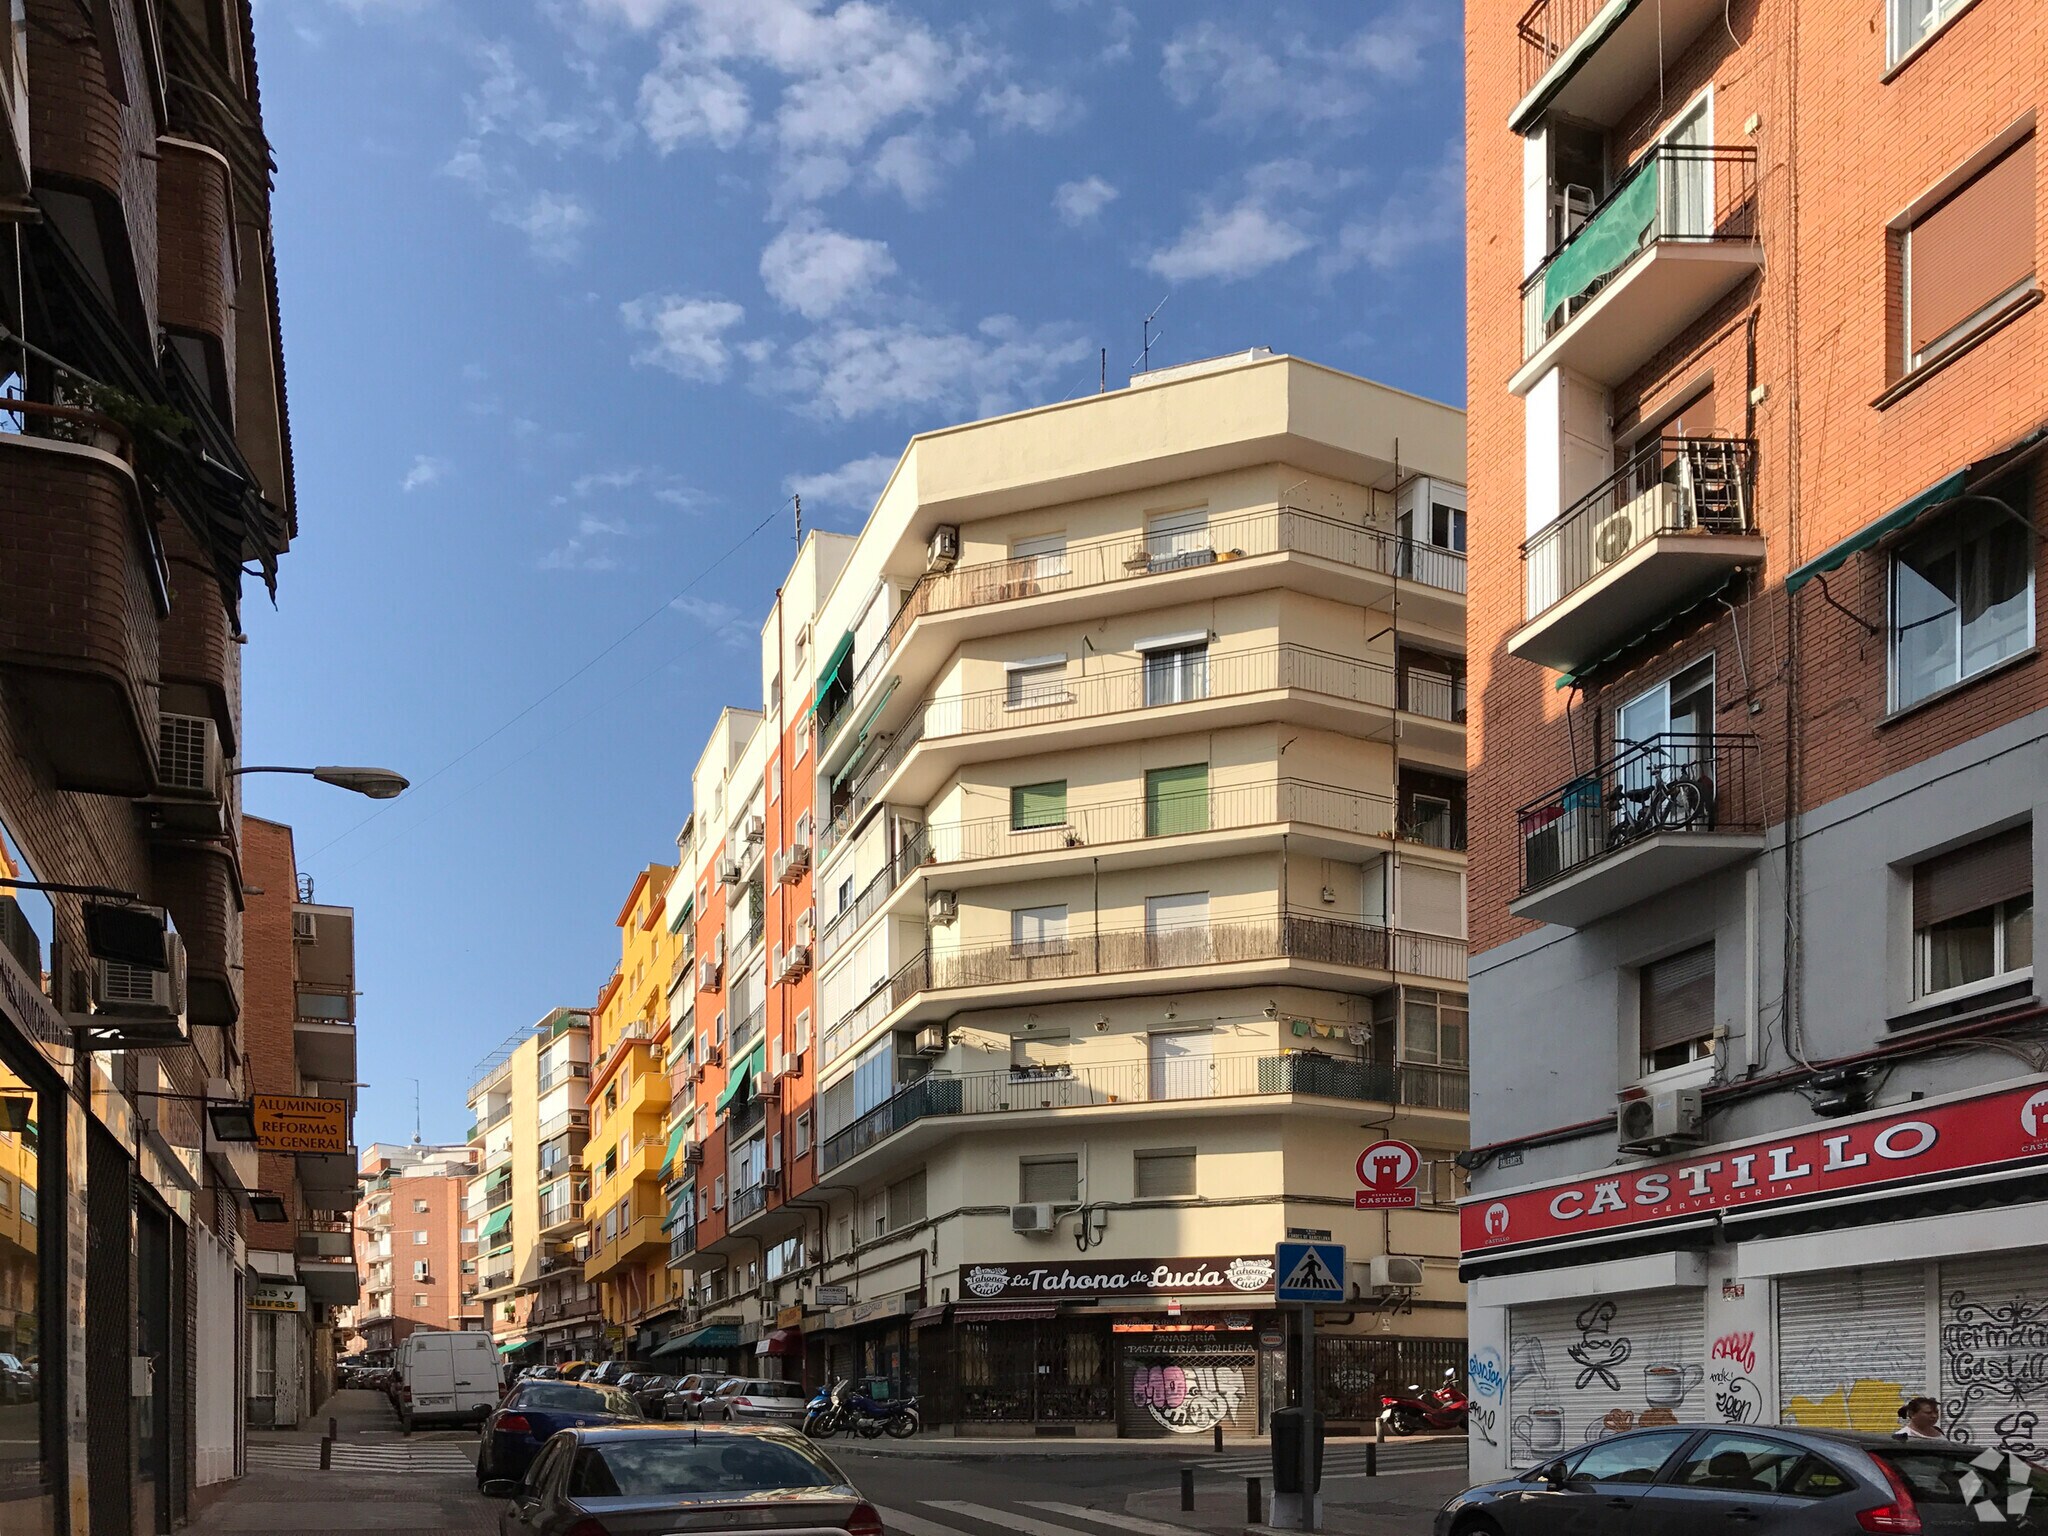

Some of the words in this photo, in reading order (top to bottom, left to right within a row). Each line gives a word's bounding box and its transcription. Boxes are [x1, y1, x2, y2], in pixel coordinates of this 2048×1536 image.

[258, 1098, 342, 1114] ALUMINIOS
[262, 1121, 338, 1135] REFORMAS
[257, 1135, 276, 1147] EN
[280, 1136, 343, 1150] GENERAL
[1549, 1121, 1938, 1220] CASTILLO
[1359, 1196, 1412, 1204] CASTILLO
[1652, 1182, 1793, 1214] CERVECERIA
[1010, 1274, 1032, 1287] La
[1028, 1268, 1130, 1291] Tahona
[1130, 1270, 1149, 1283] de
[1146, 1263, 1225, 1288] Lucía
[1231, 1266, 1267, 1276] Tahona
[284, 1290, 294, 1300] y
[1153, 1332, 1217, 1343] PANADERÍA
[1204, 1342, 1256, 1353] BOLLERÍA
